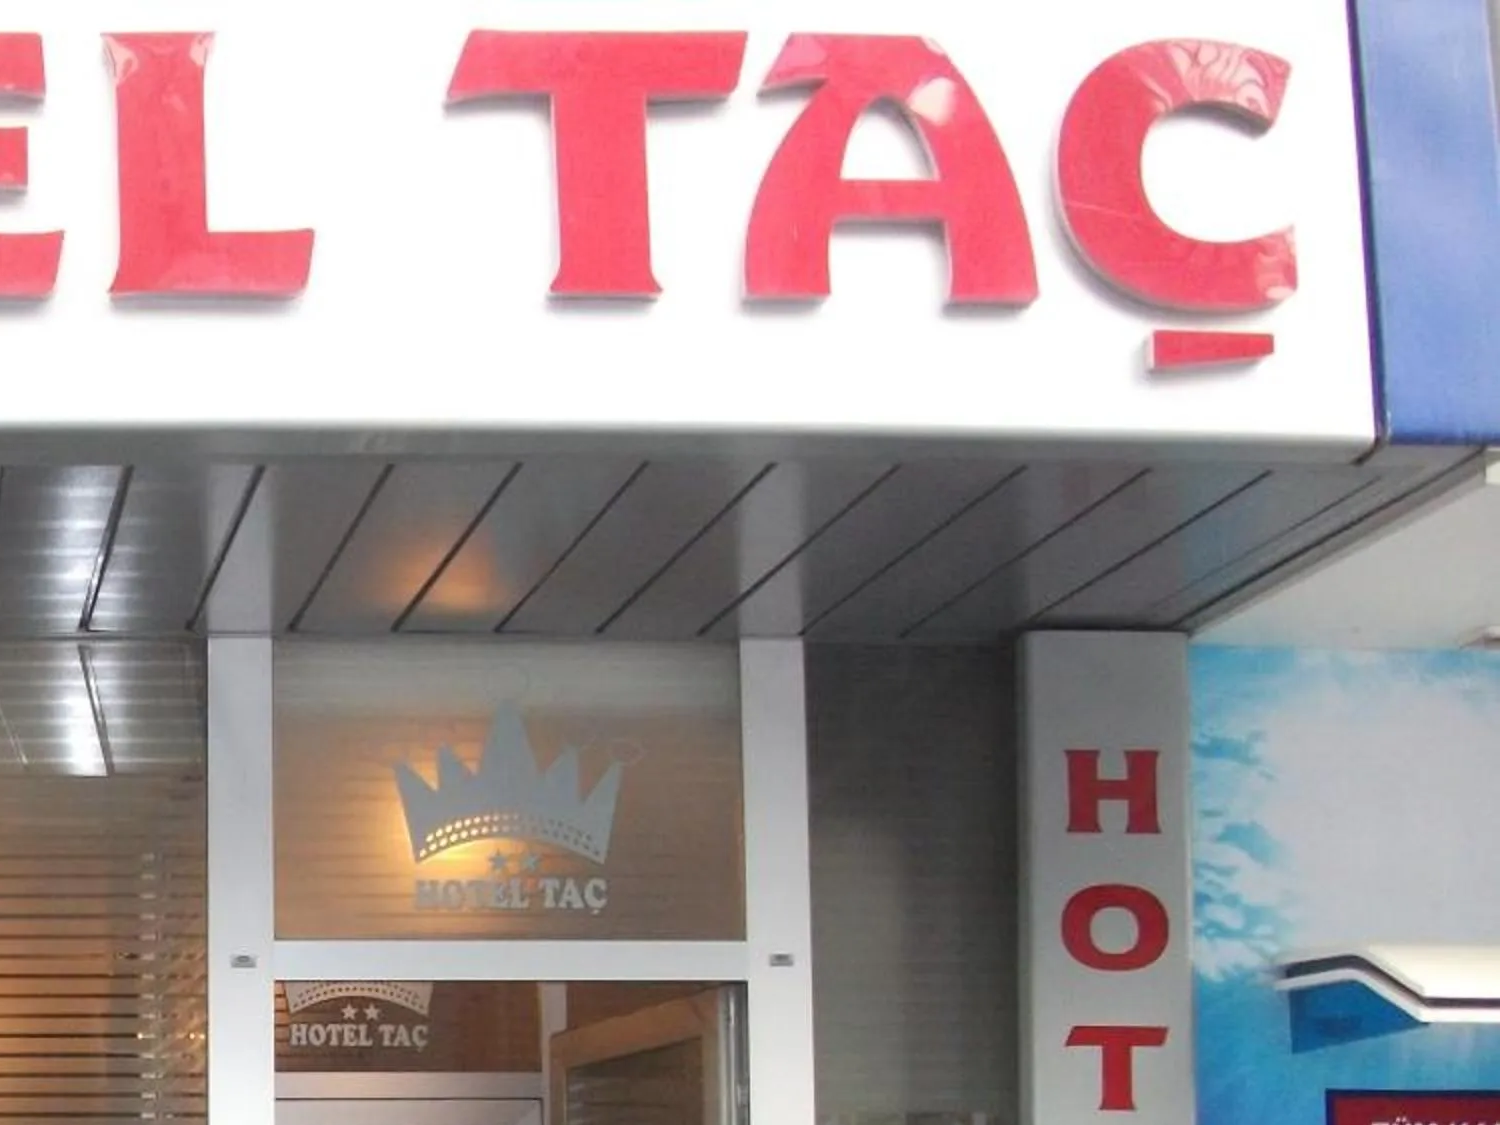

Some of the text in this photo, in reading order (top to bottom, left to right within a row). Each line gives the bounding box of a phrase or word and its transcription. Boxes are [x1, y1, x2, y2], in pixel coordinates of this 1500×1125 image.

[443, 28, 1299, 373] TAÇ
[414, 876, 609, 915] HOTEL TAÇ
[289, 1022, 429, 1053] HOTEL TAÇ
